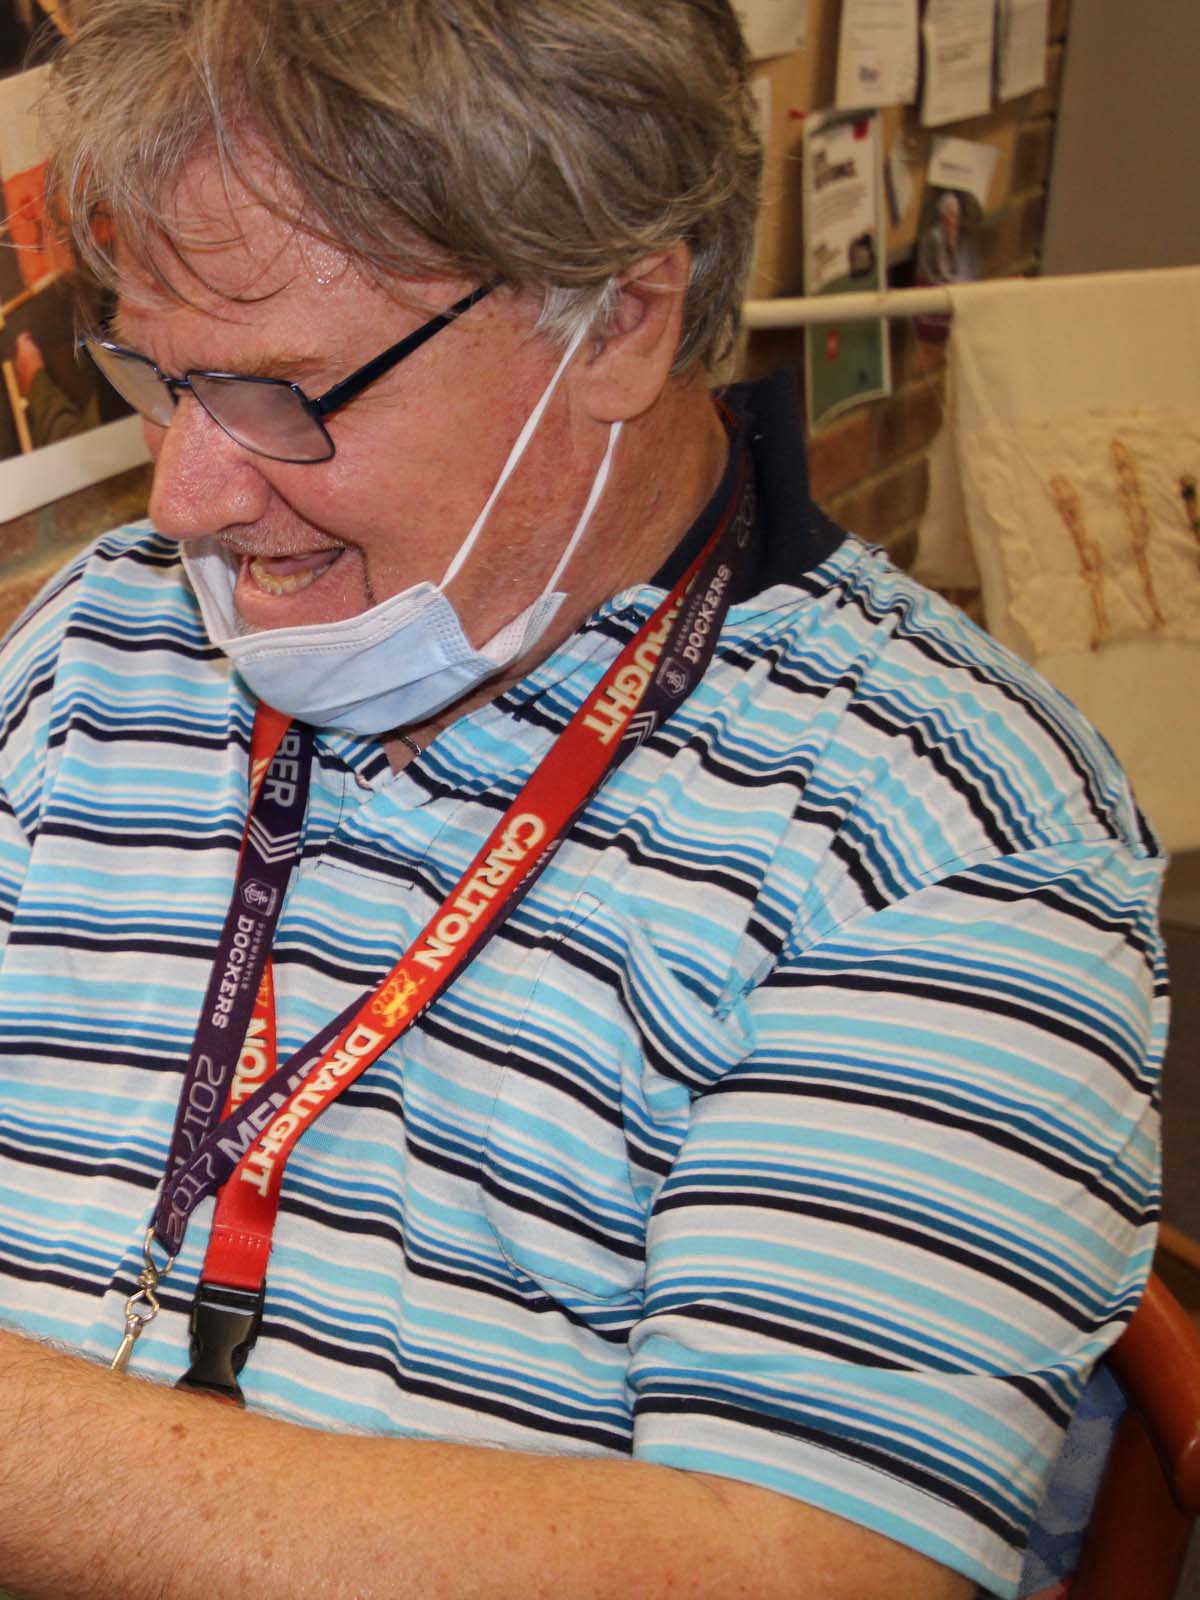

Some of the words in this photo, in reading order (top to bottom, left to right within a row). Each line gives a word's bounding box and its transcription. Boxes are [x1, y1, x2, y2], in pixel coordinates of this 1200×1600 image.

[682, 564, 731, 665] DOCKERS
[265, 731, 301, 808] BER
[412, 812, 546, 972] CARLTON
[211, 913, 256, 1030] DOCKERS
[240, 1024, 384, 1198] DRAUGHT
[166, 1152, 217, 1245] 2017
